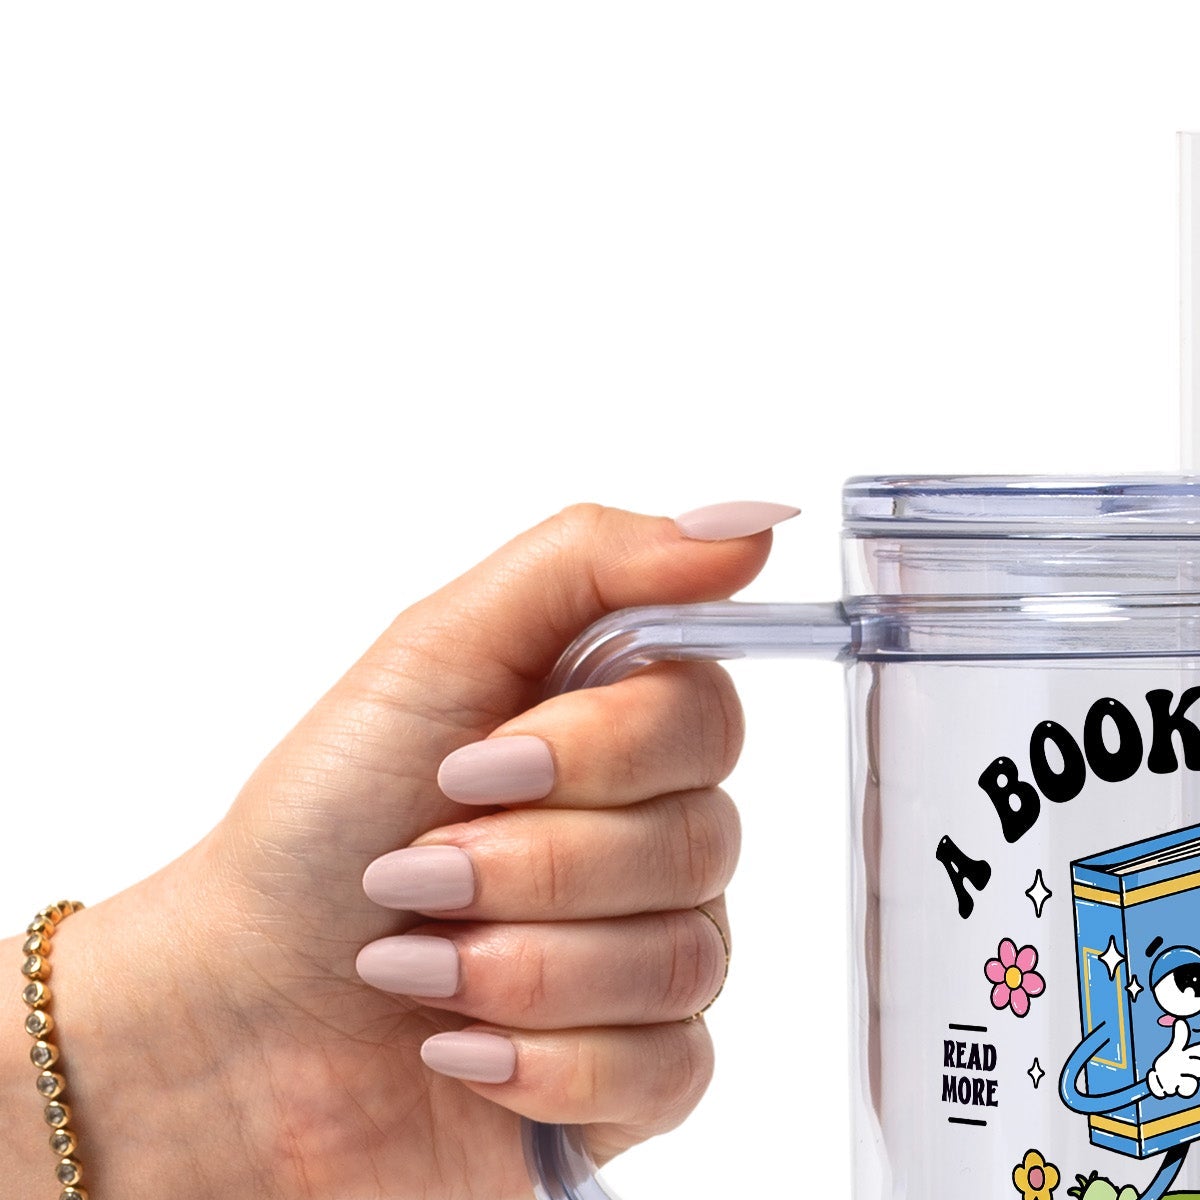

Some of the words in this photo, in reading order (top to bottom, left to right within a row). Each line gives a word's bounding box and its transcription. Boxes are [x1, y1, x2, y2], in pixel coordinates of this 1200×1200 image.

[935, 834, 992, 920] A
[943, 1039, 997, 1072] READ
[941, 1074, 999, 1108] MORE
